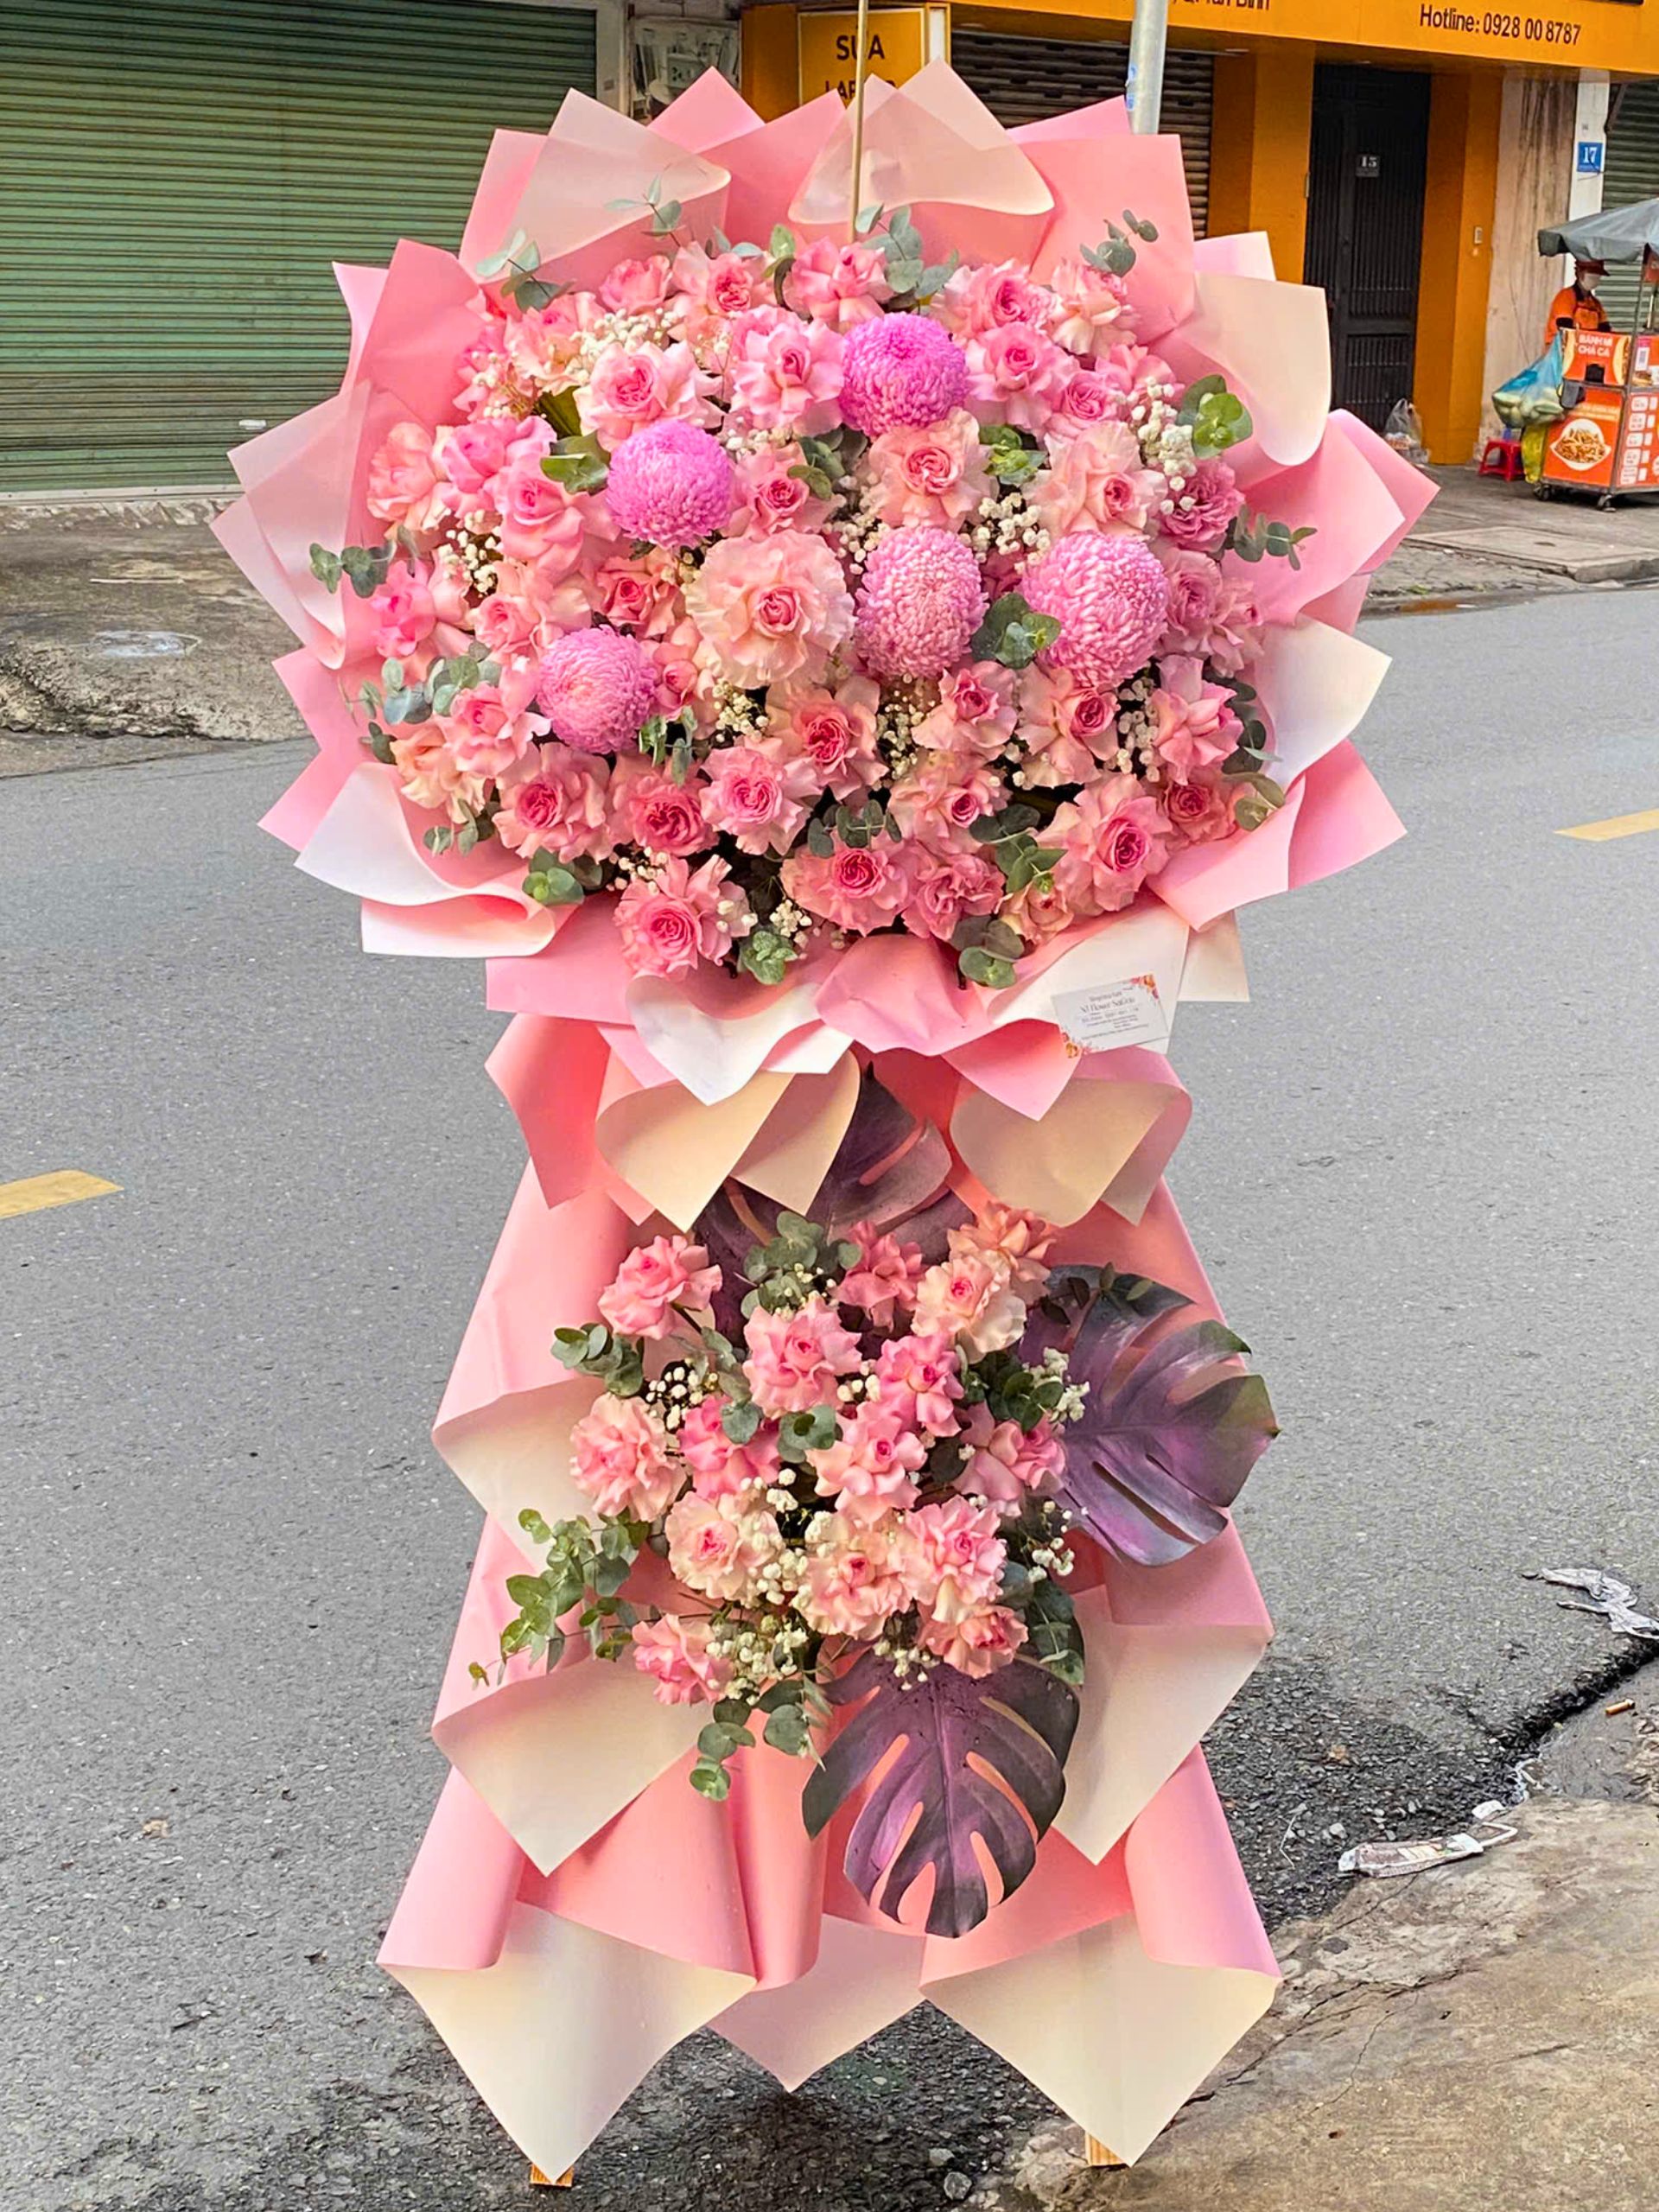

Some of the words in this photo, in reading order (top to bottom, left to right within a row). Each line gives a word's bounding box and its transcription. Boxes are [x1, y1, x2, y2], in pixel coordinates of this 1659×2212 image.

[1420, 3, 1480, 33] Hotline:
[1483, 12, 1520, 38] 0928
[1524, 18, 1542, 41] 00
[1545, 21, 1581, 45] 8787
[1583, 147, 1597, 163] 17
